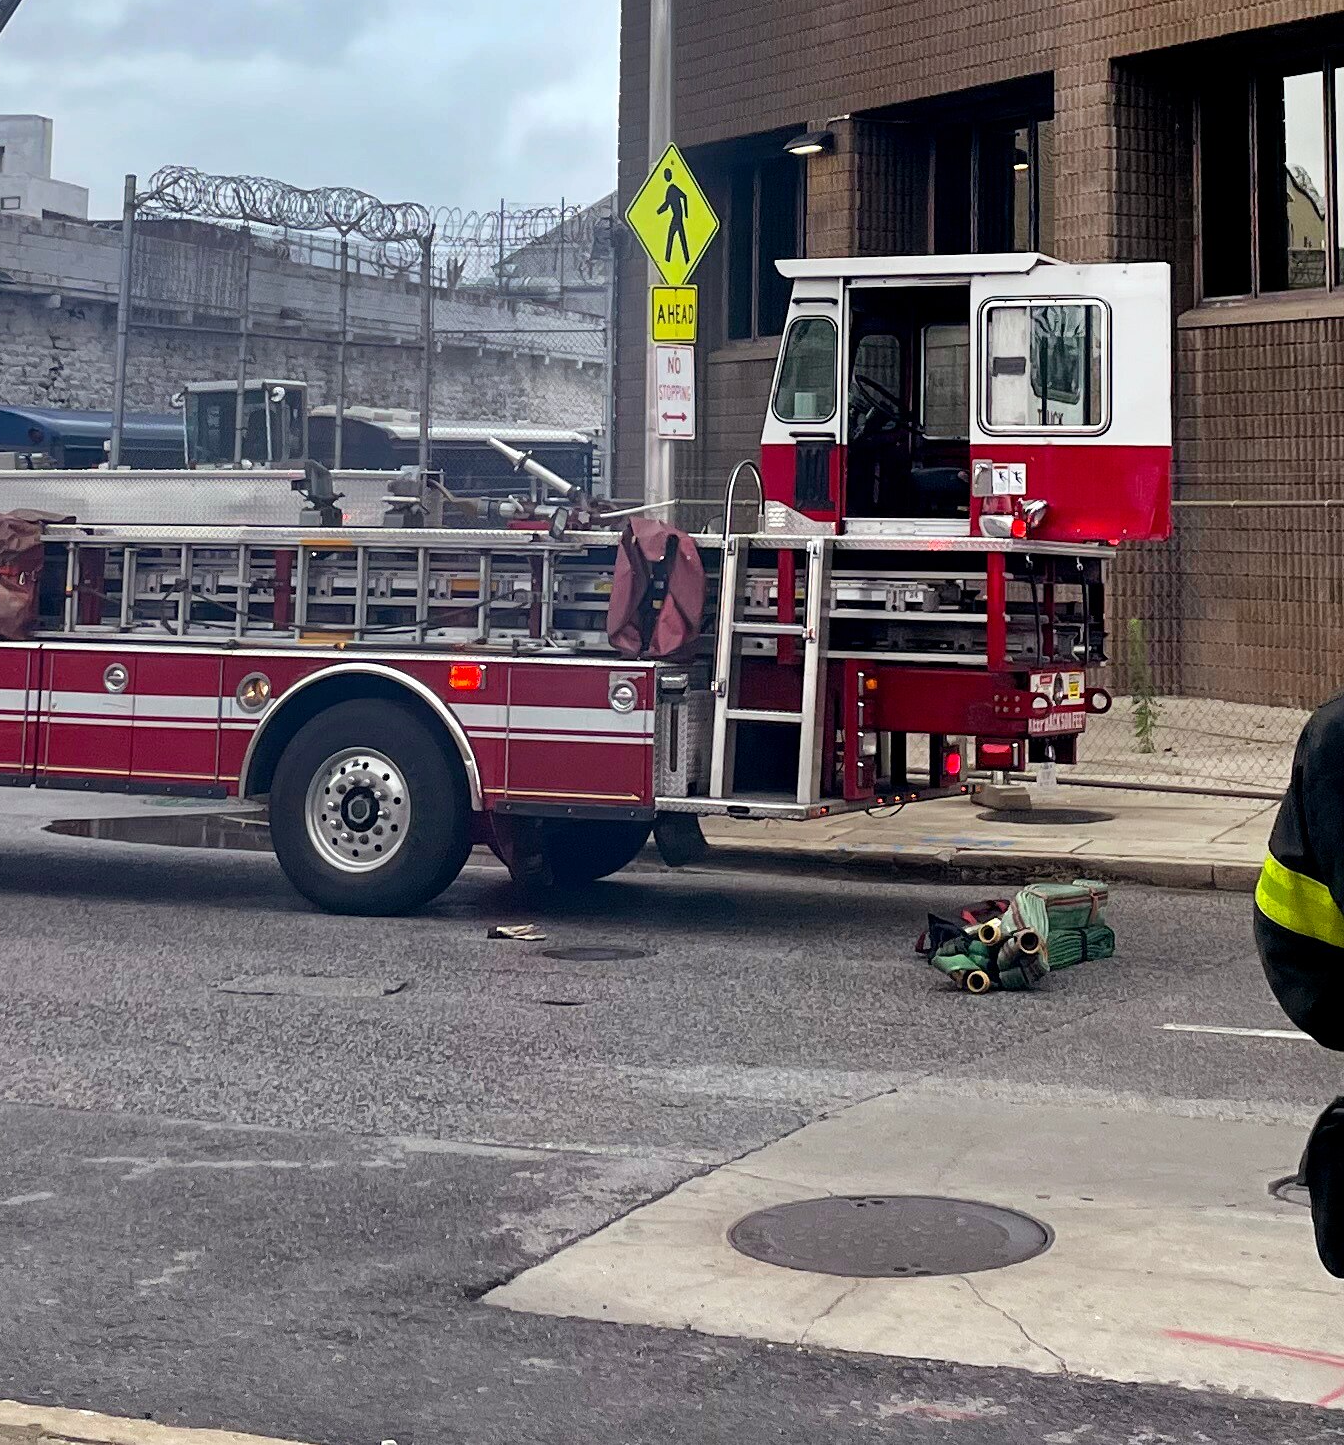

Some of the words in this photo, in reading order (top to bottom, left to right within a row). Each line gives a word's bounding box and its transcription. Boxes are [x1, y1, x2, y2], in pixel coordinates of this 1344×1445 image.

[656, 304, 694, 325] AHEAD
[667, 356, 681, 375] NO
[658, 384, 691, 402] STOPPING
